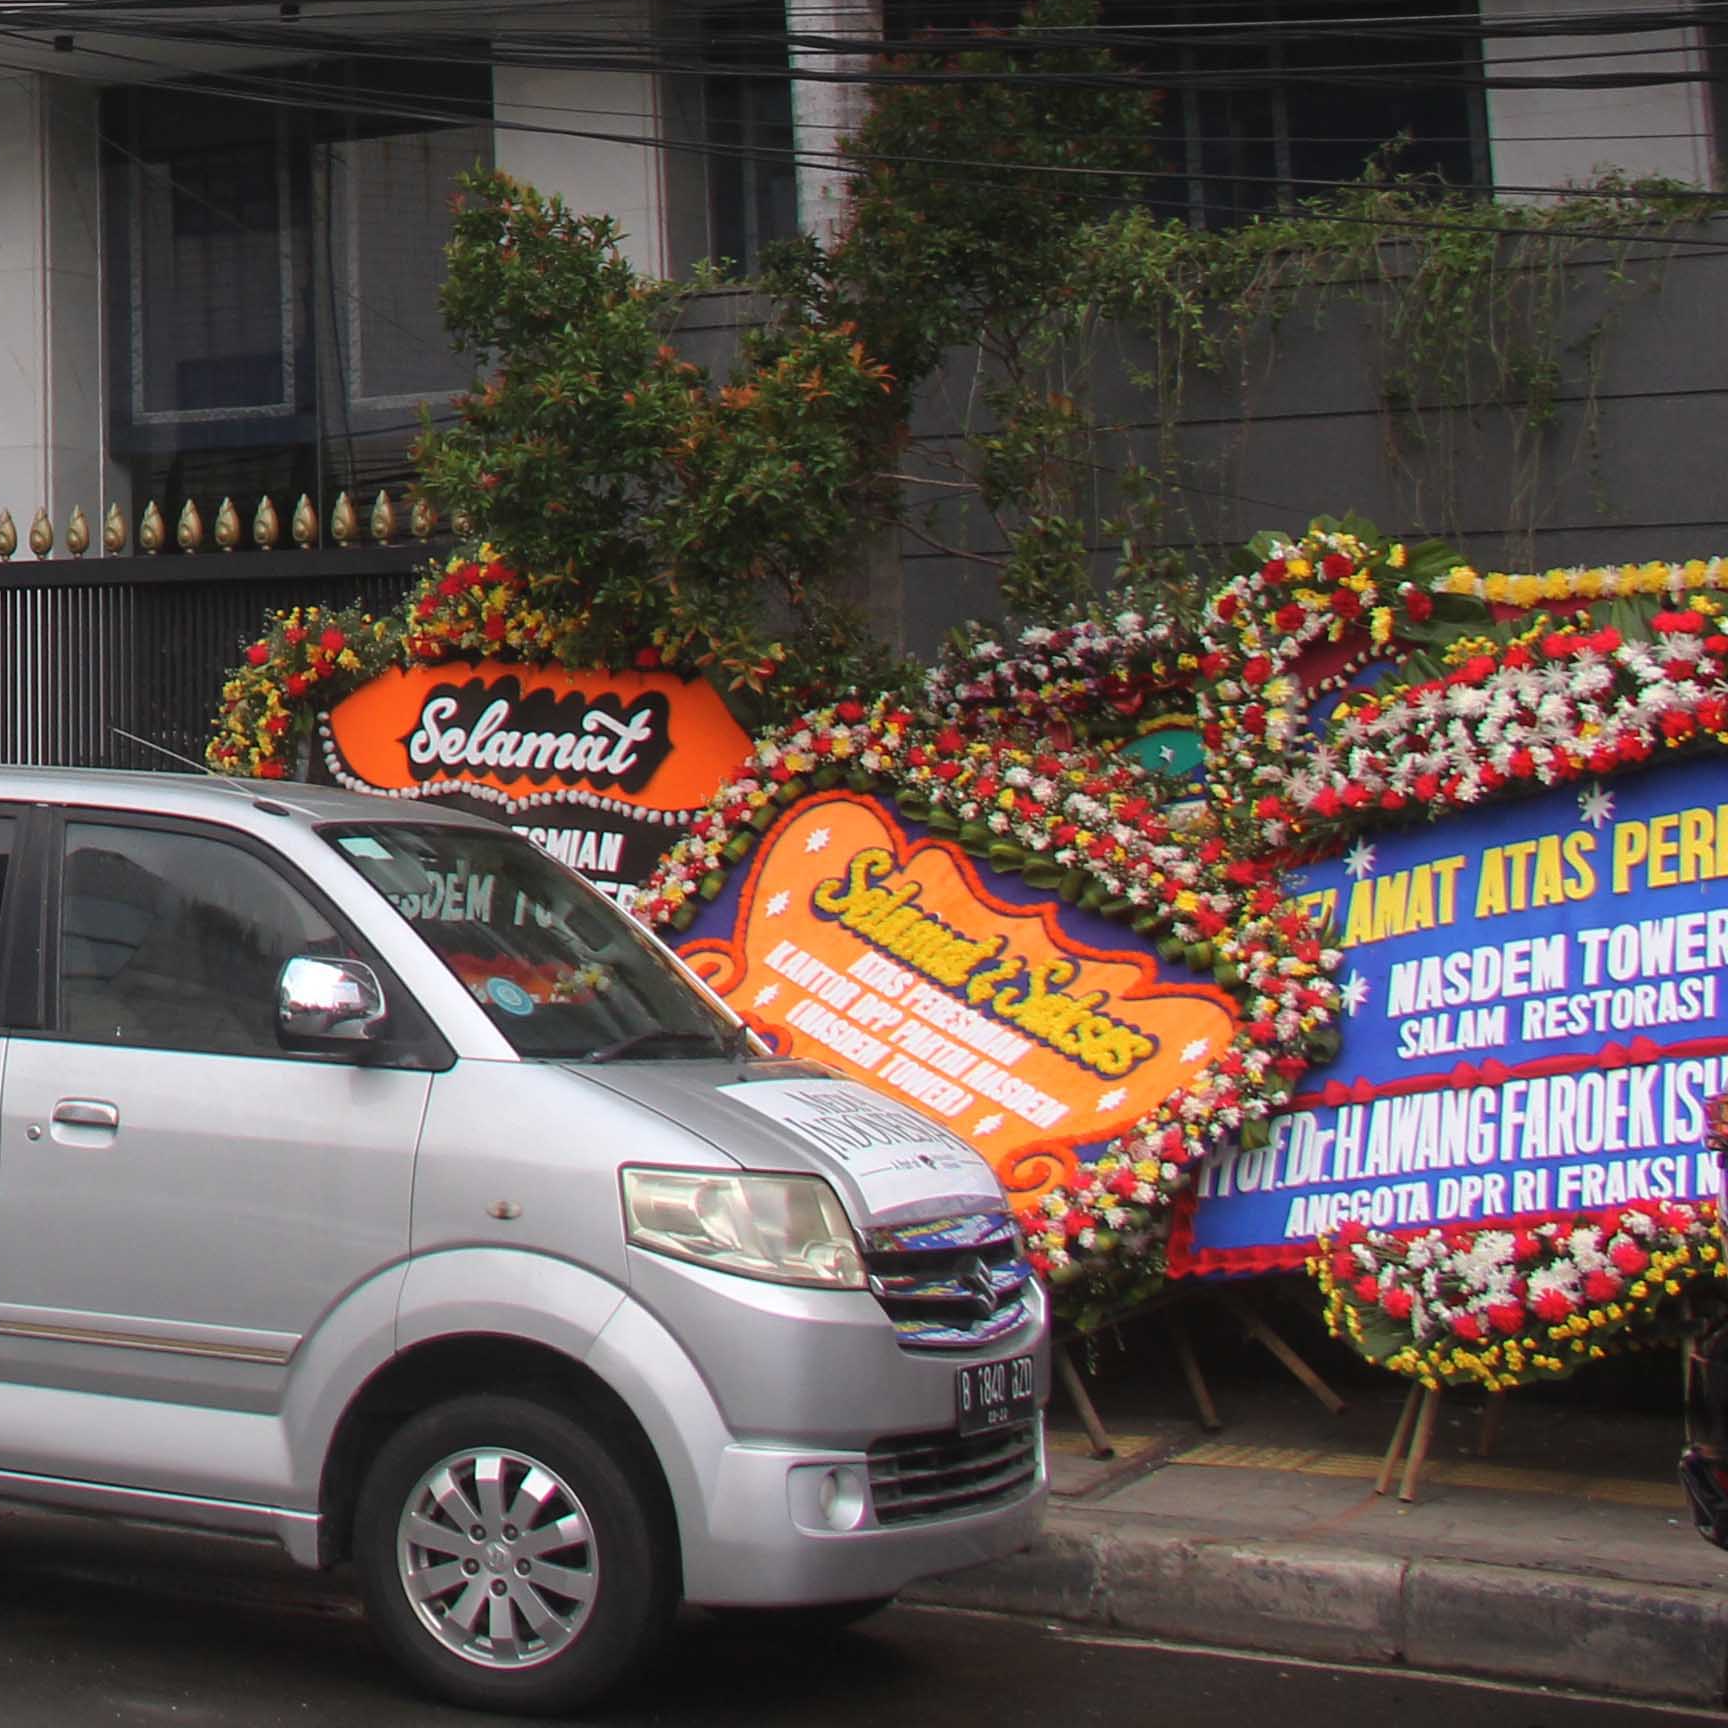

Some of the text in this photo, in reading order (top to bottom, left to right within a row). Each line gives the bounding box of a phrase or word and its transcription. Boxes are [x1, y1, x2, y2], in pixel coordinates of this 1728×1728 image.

[410, 697, 651, 775] Selamat
[1475, 830, 1596, 918] ATAS
[814, 849, 1006, 987] Selamat
[993, 959, 1156, 1075] Sukses
[847, 951, 1033, 1067] ATAS PERESMIAN
[1387, 909, 1728, 1017] NASDEM TOWER
[763, 939, 1071, 1129] KANTOR DPP PARTAI NASDEM
[785, 999, 975, 1117] (NASDEM TOWER)
[1397, 975, 1716, 1059] SALAM RESTORASI
[1499, 1064, 1661, 1161] FAROEK
[1284, 1181, 1431, 1238] ANGGOTA
[1436, 1172, 1505, 1220] DPR
[1512, 1168, 1549, 1212] RI
[1557, 1156, 1688, 1209] FRAKSI
[962, 1370, 971, 1411] B
